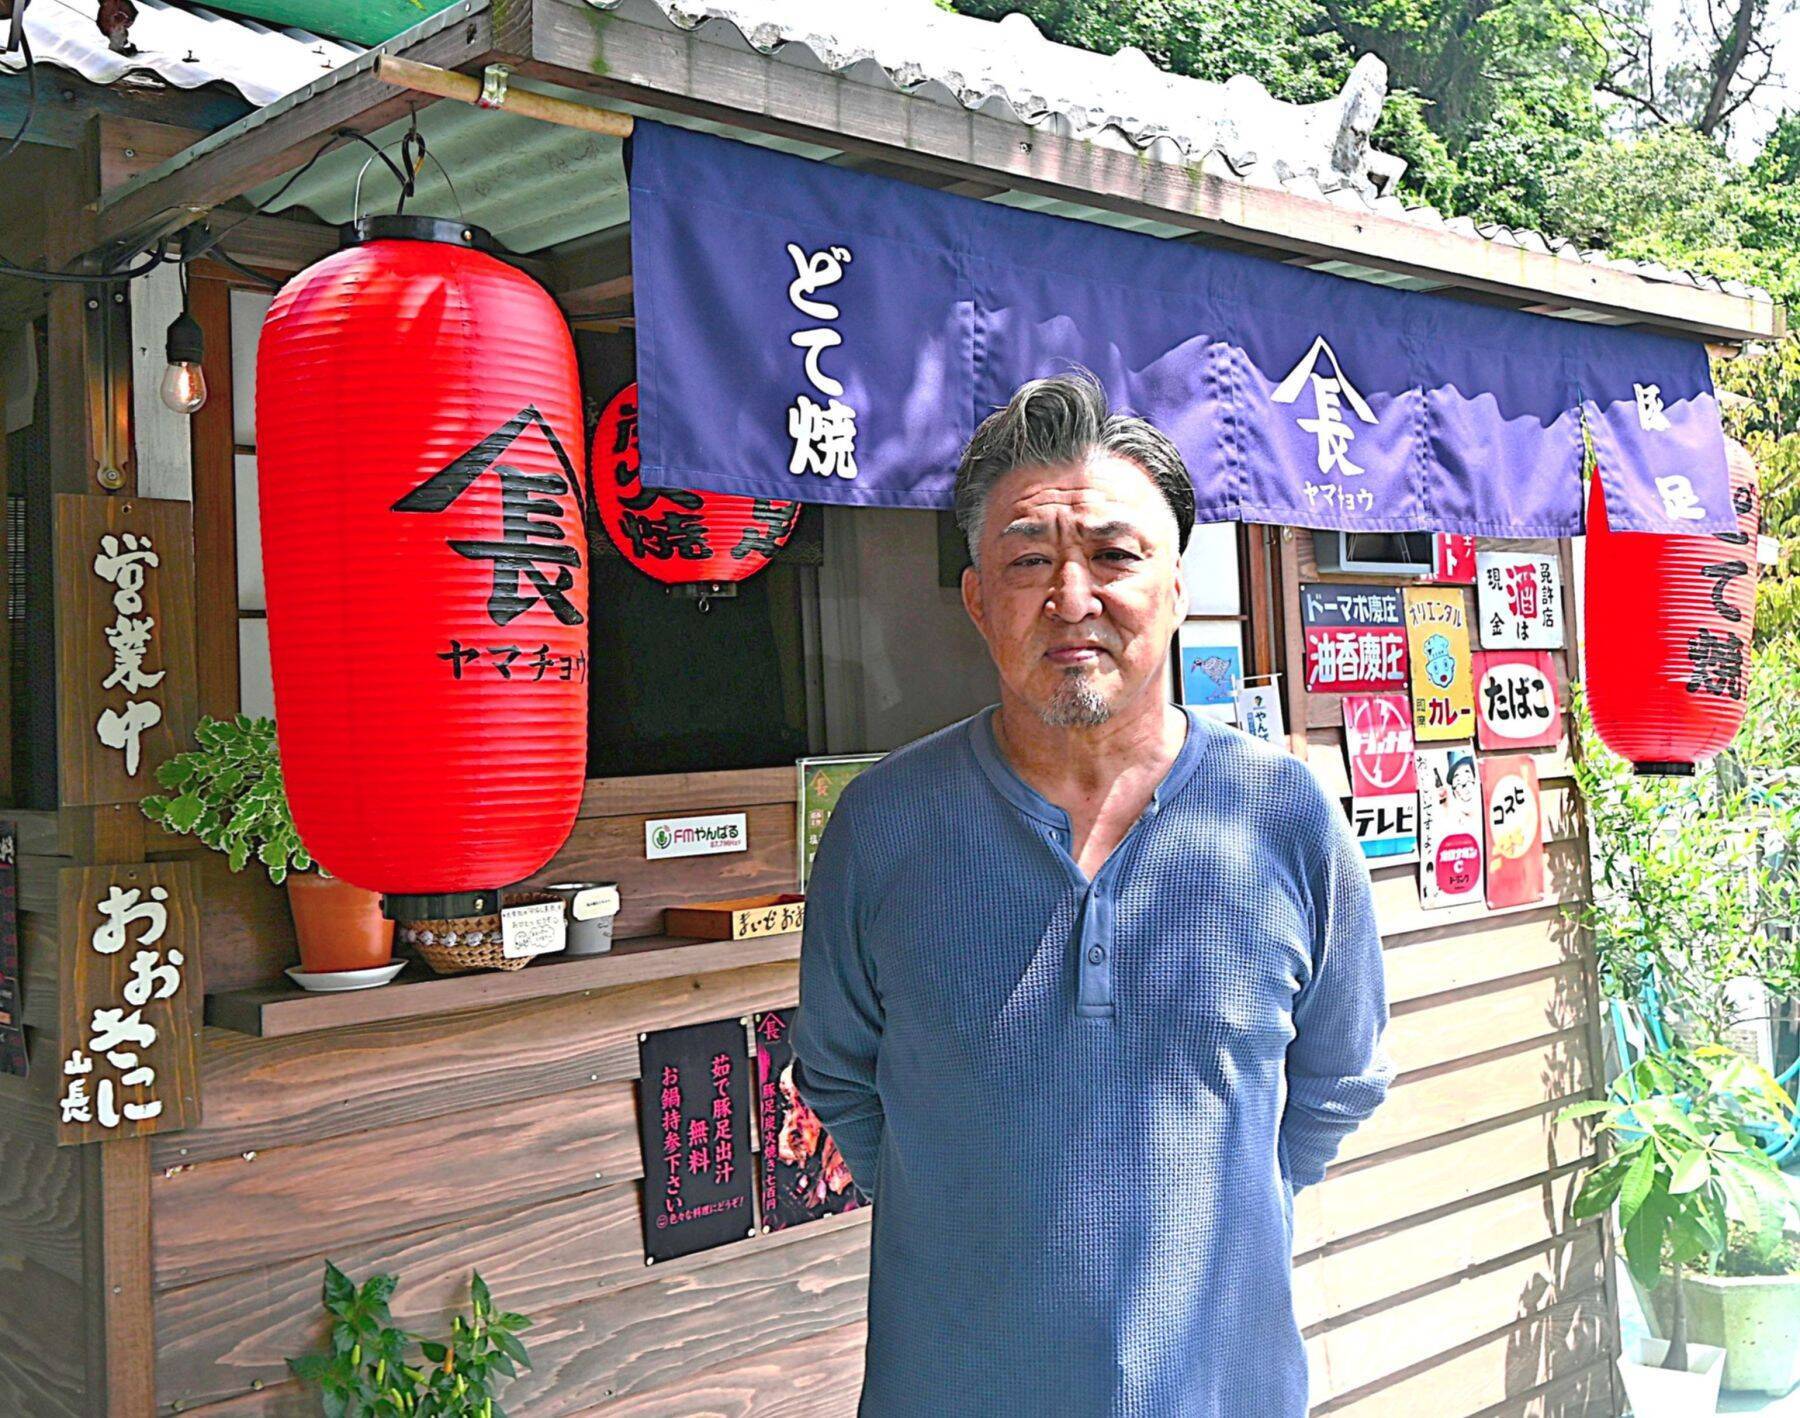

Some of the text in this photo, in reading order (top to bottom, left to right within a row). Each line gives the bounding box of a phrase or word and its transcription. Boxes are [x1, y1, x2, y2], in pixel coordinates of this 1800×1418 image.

[786, 242, 858, 480] どて焼
[1409, 600, 1463, 628] オリエンタル
[1539, 562, 1555, 628] 免許店
[93, 532, 167, 777] 営業中
[436, 638, 587, 686] ヤマチョウ
[1428, 697, 1472, 727] カレー
[1483, 675, 1550, 722] たばこ
[673, 824, 739, 844] FMやんばる
[1355, 806, 1414, 838] テレビ
[659, 1065, 684, 1213] お鍋持参下さい
[710, 1053, 735, 1185] 茹で豚足出汁
[687, 1119, 711, 1176] 無料
